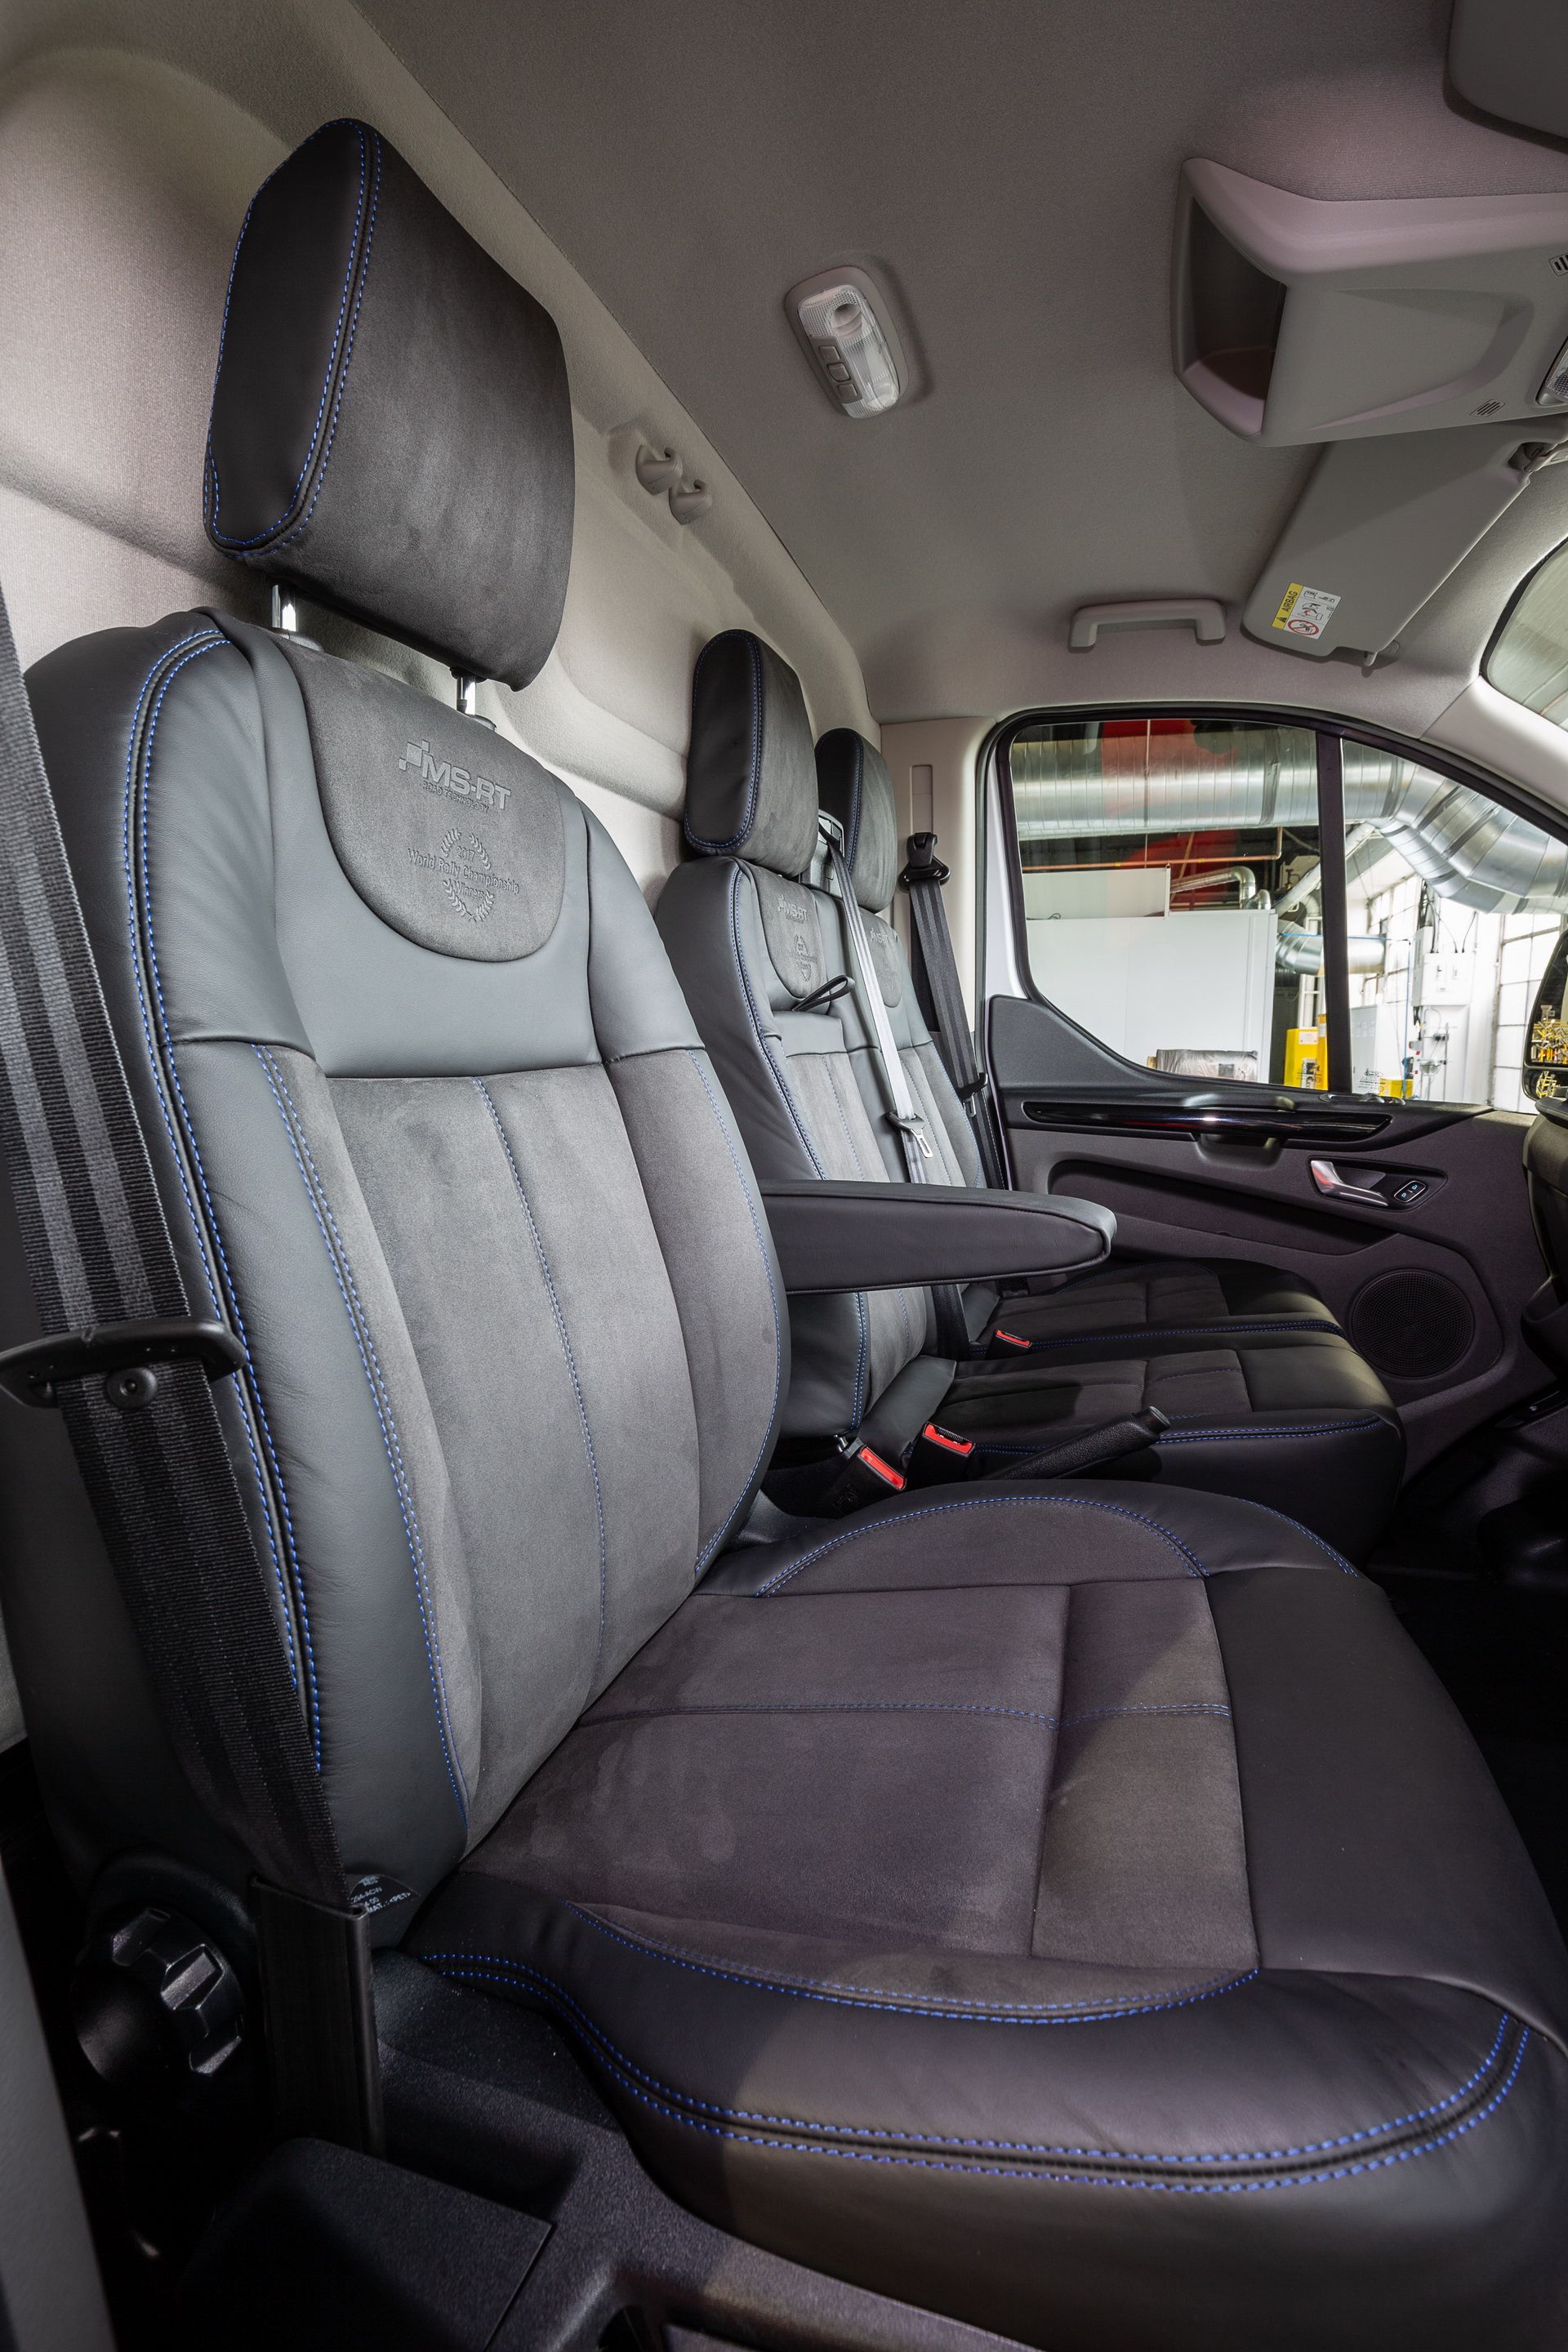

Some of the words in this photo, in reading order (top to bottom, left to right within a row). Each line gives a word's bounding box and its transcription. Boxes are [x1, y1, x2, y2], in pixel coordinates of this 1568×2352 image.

[1282, 590, 1298, 612] AIRBAG
[422, 781, 442, 795] ROAD
[445, 790, 489, 813] TECHNOLOGY
[457, 846, 475, 862] 2017
[408, 849, 435, 869] World
[439, 858, 461, 878] Rally
[463, 866, 520, 894] Championship
[453, 880, 485, 899] Winners
